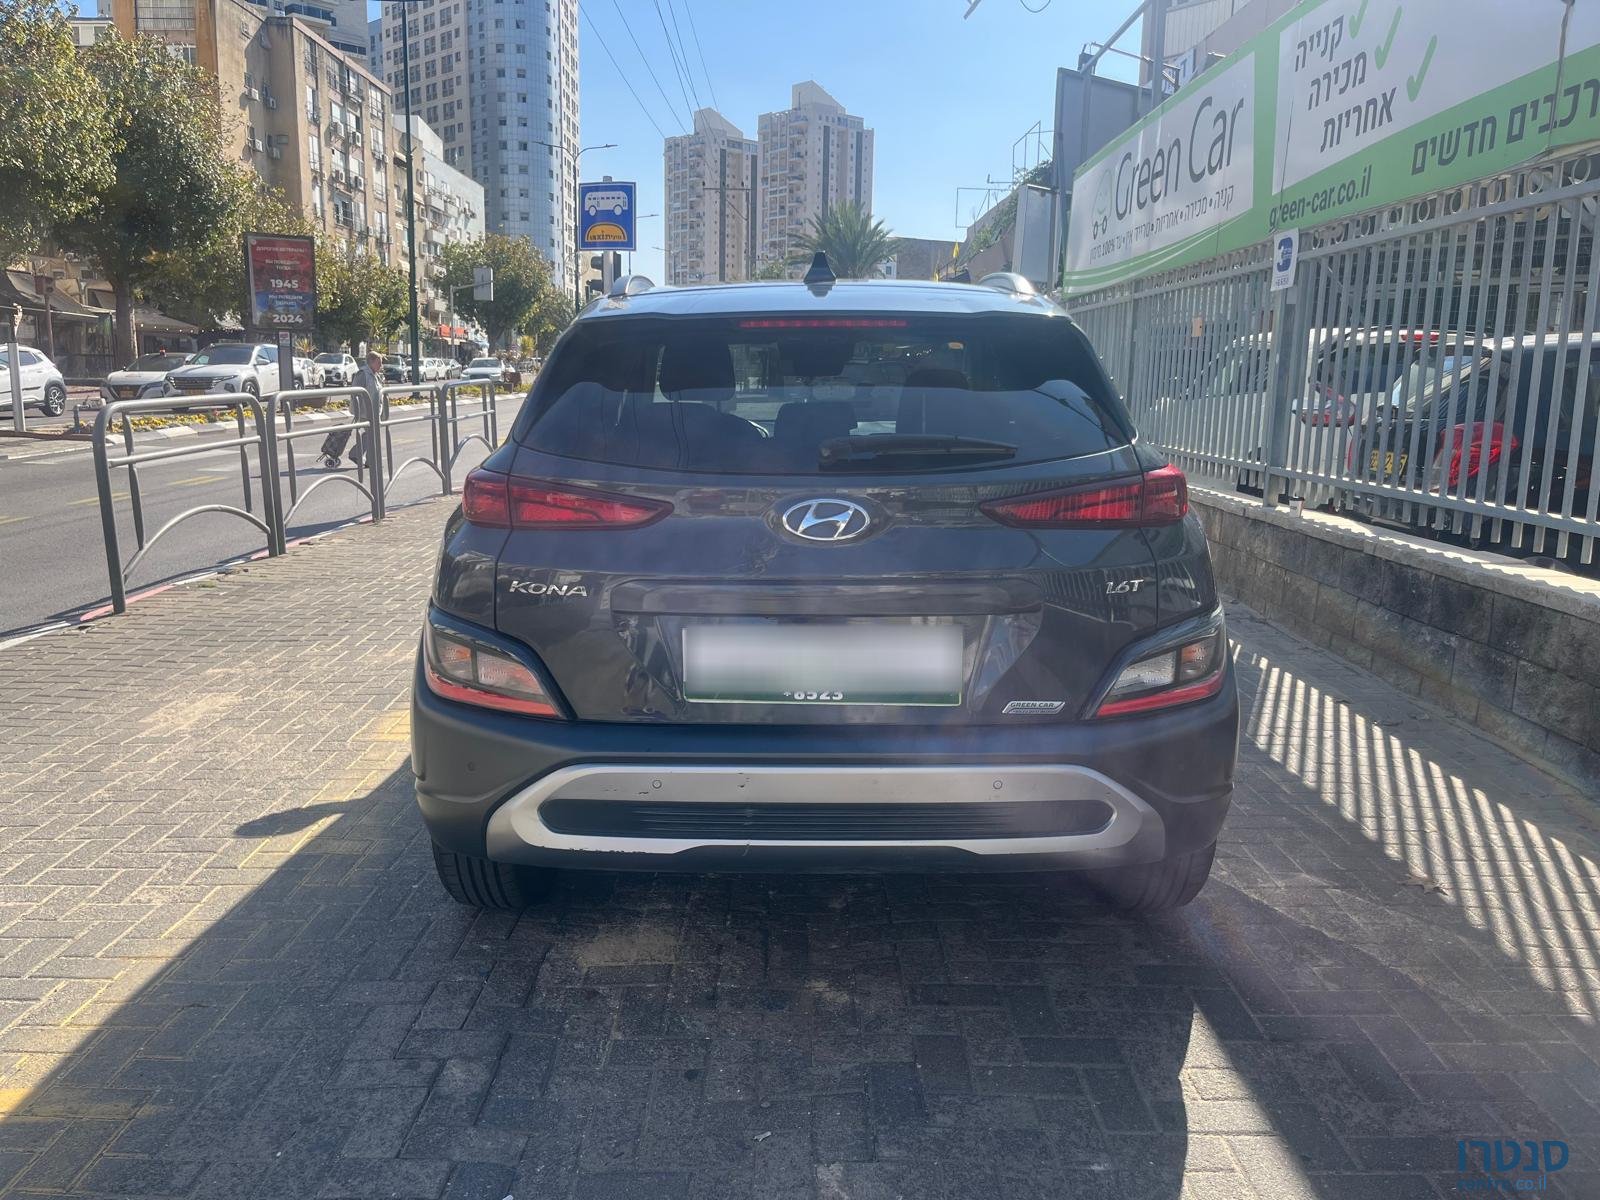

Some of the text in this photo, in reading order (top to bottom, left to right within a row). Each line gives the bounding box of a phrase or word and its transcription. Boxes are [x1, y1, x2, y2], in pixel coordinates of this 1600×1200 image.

[1294, 14, 1345, 73] קנייה
[1307, 51, 1368, 111] מכירה
[1320, 86, 1398, 153] אחריות
[1411, 78, 1600, 176] רכבים חדשים
[1115, 96, 1245, 221] Green Car
[1183, 196, 1208, 222] מכירה
[1213, 185, 1235, 211] קניה
[1154, 208, 1180, 235] אחריות
[270, 279, 299, 289] 1945
[272, 314, 304, 324] 2024
[508, 580, 588, 597] KONA
